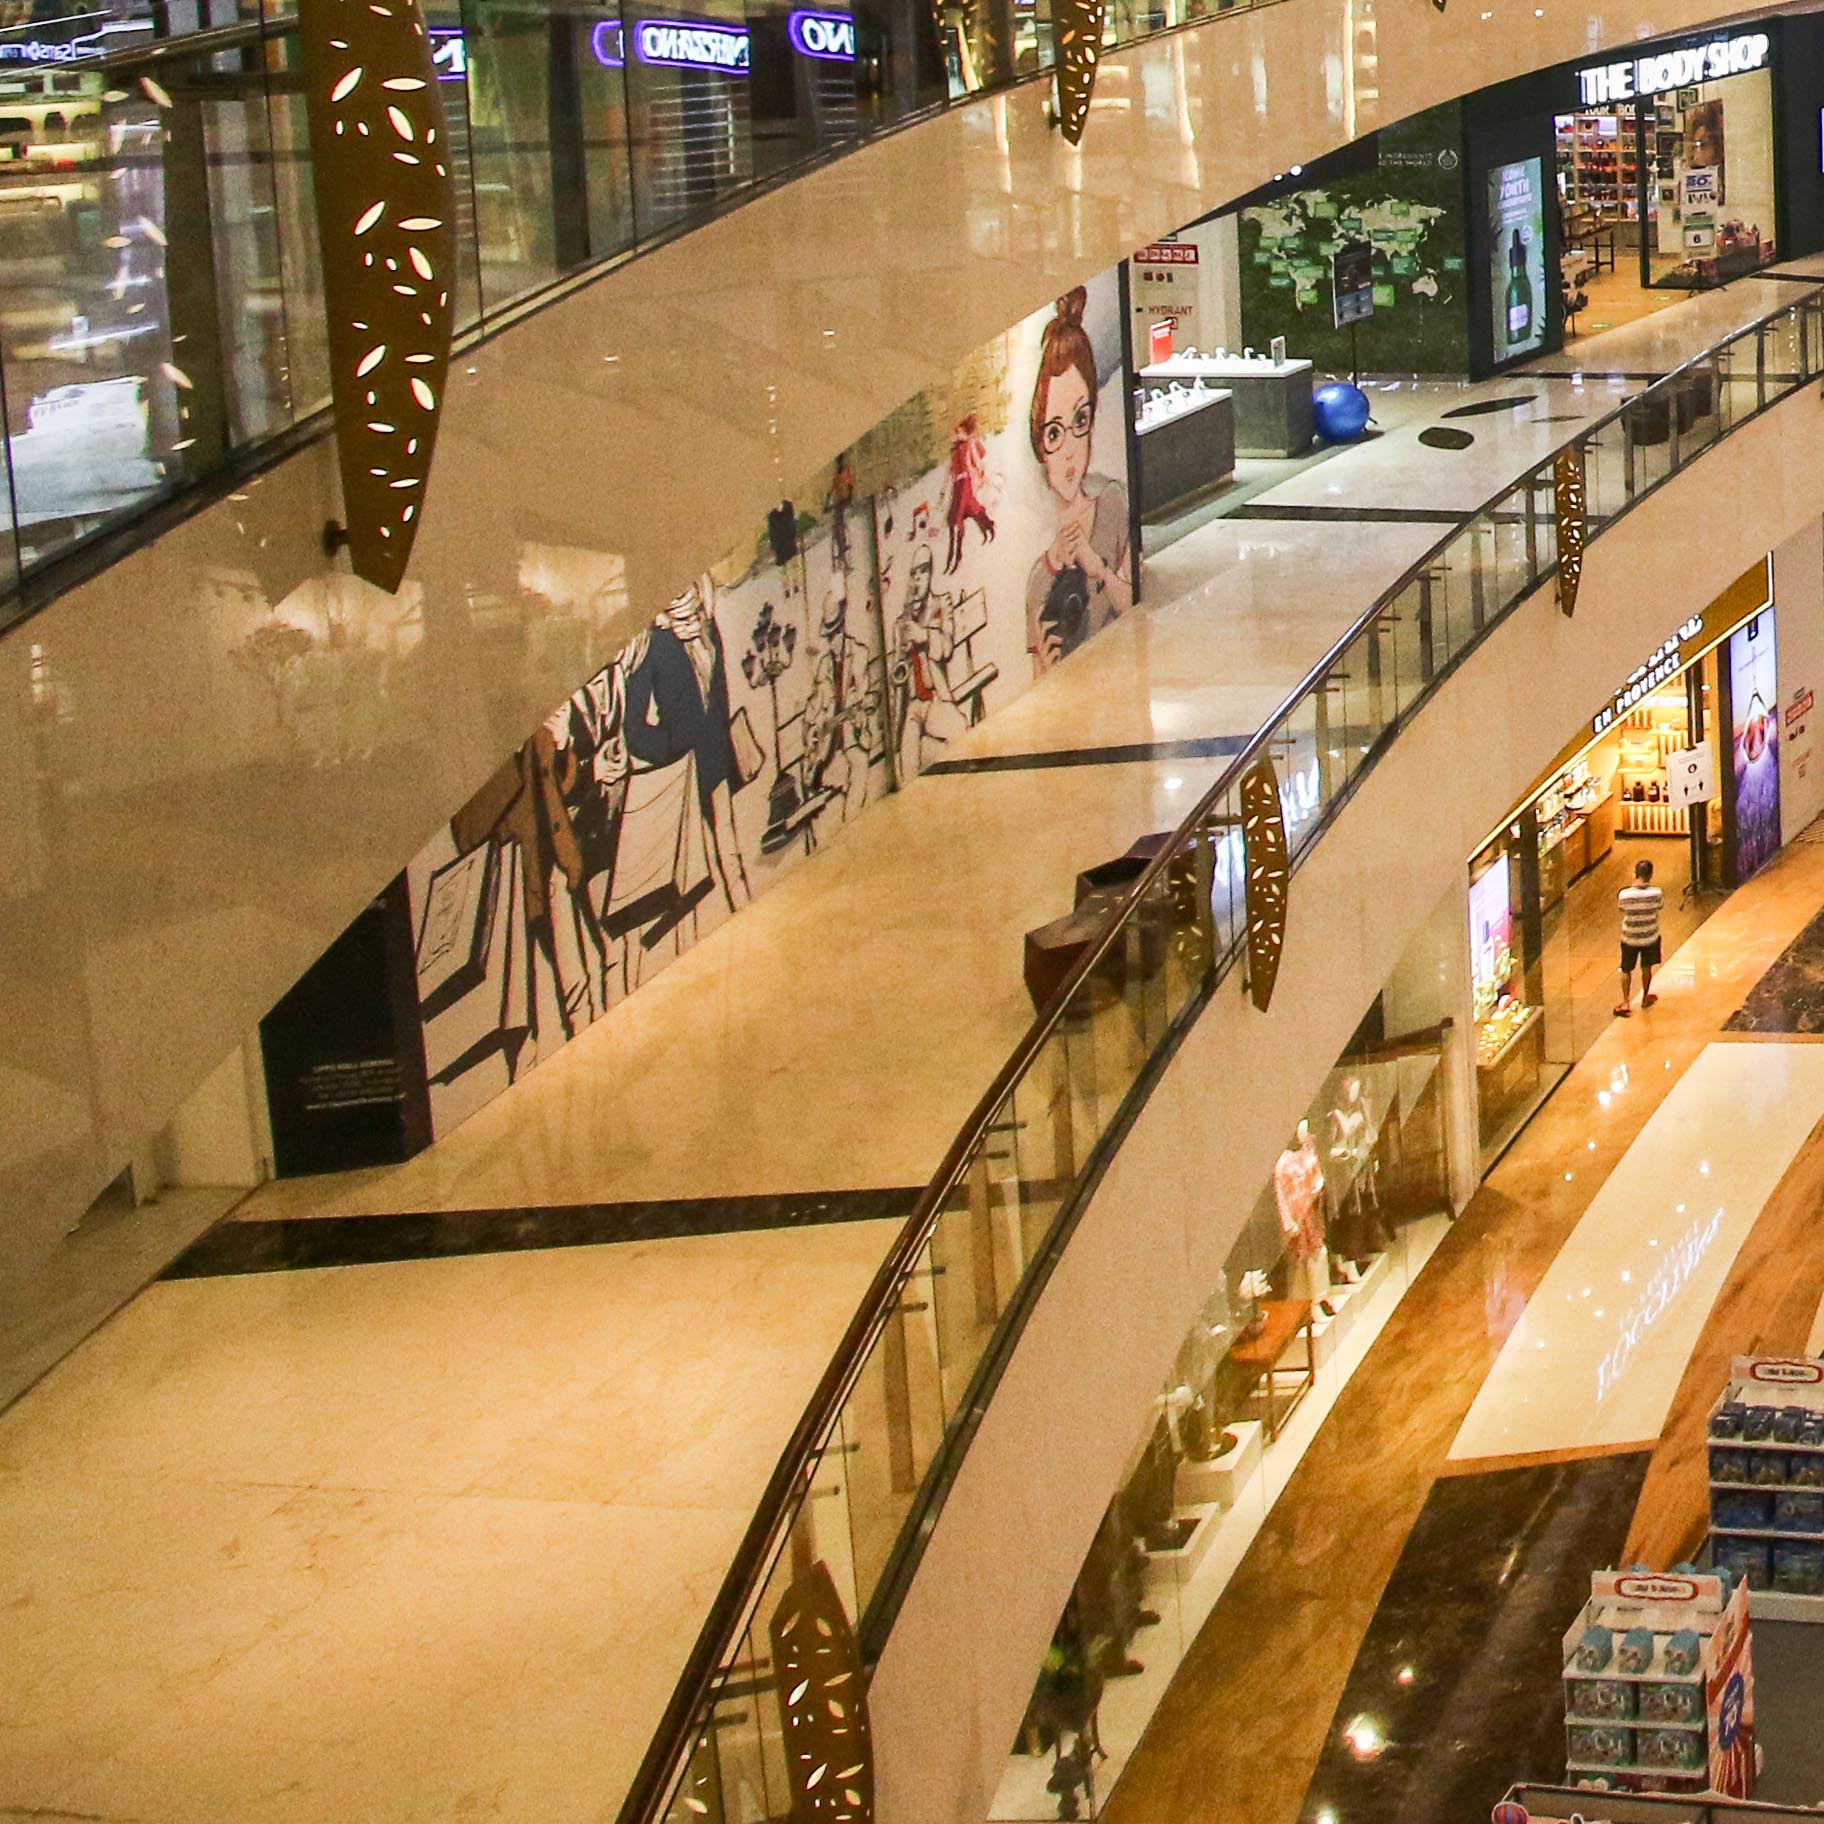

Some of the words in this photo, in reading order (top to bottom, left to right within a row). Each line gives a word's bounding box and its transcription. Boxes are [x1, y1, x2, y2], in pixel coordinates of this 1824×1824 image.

[1580, 62, 1635, 105] THE
[1637, 46, 1706, 95] BODY
[1708, 33, 1770, 78] SHOP
[1148, 305, 1193, 316] HYDRANT
[1593, 708, 1613, 734] EN
[1615, 652, 1680, 714] PROVENCE
